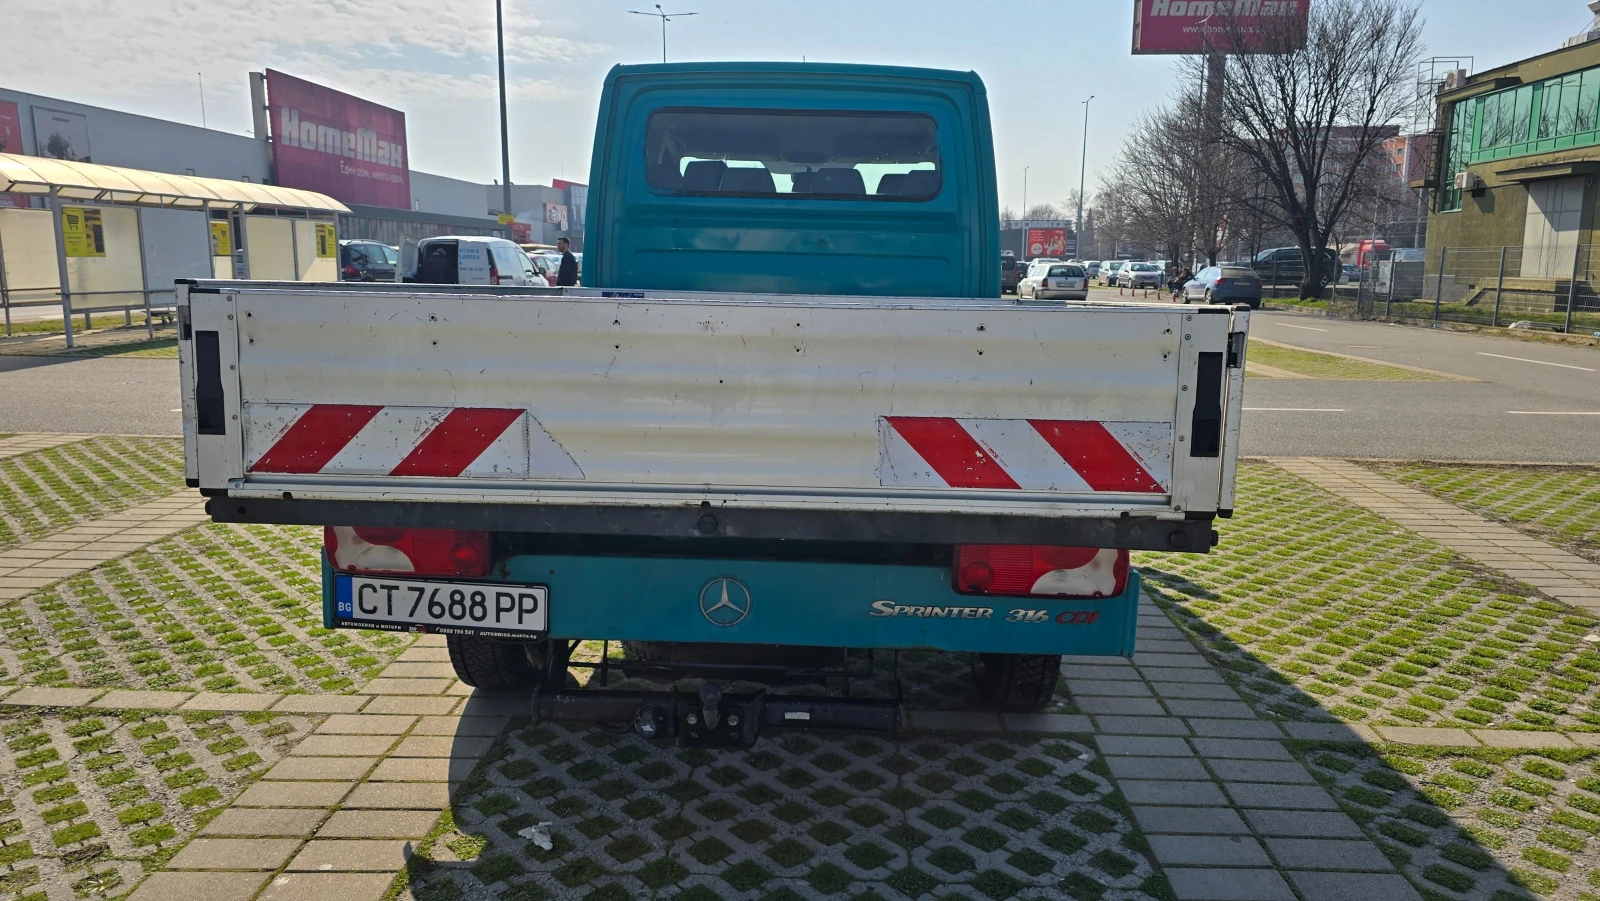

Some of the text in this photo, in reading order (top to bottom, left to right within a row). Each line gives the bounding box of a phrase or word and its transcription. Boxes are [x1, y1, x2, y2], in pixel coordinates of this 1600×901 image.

[281, 107, 402, 168] HomeMax
[338, 601, 352, 612] BG
[358, 583, 539, 624] CT 7688 PP
[1005, 608, 1050, 623] 316
[1055, 611, 1100, 624] CDI
